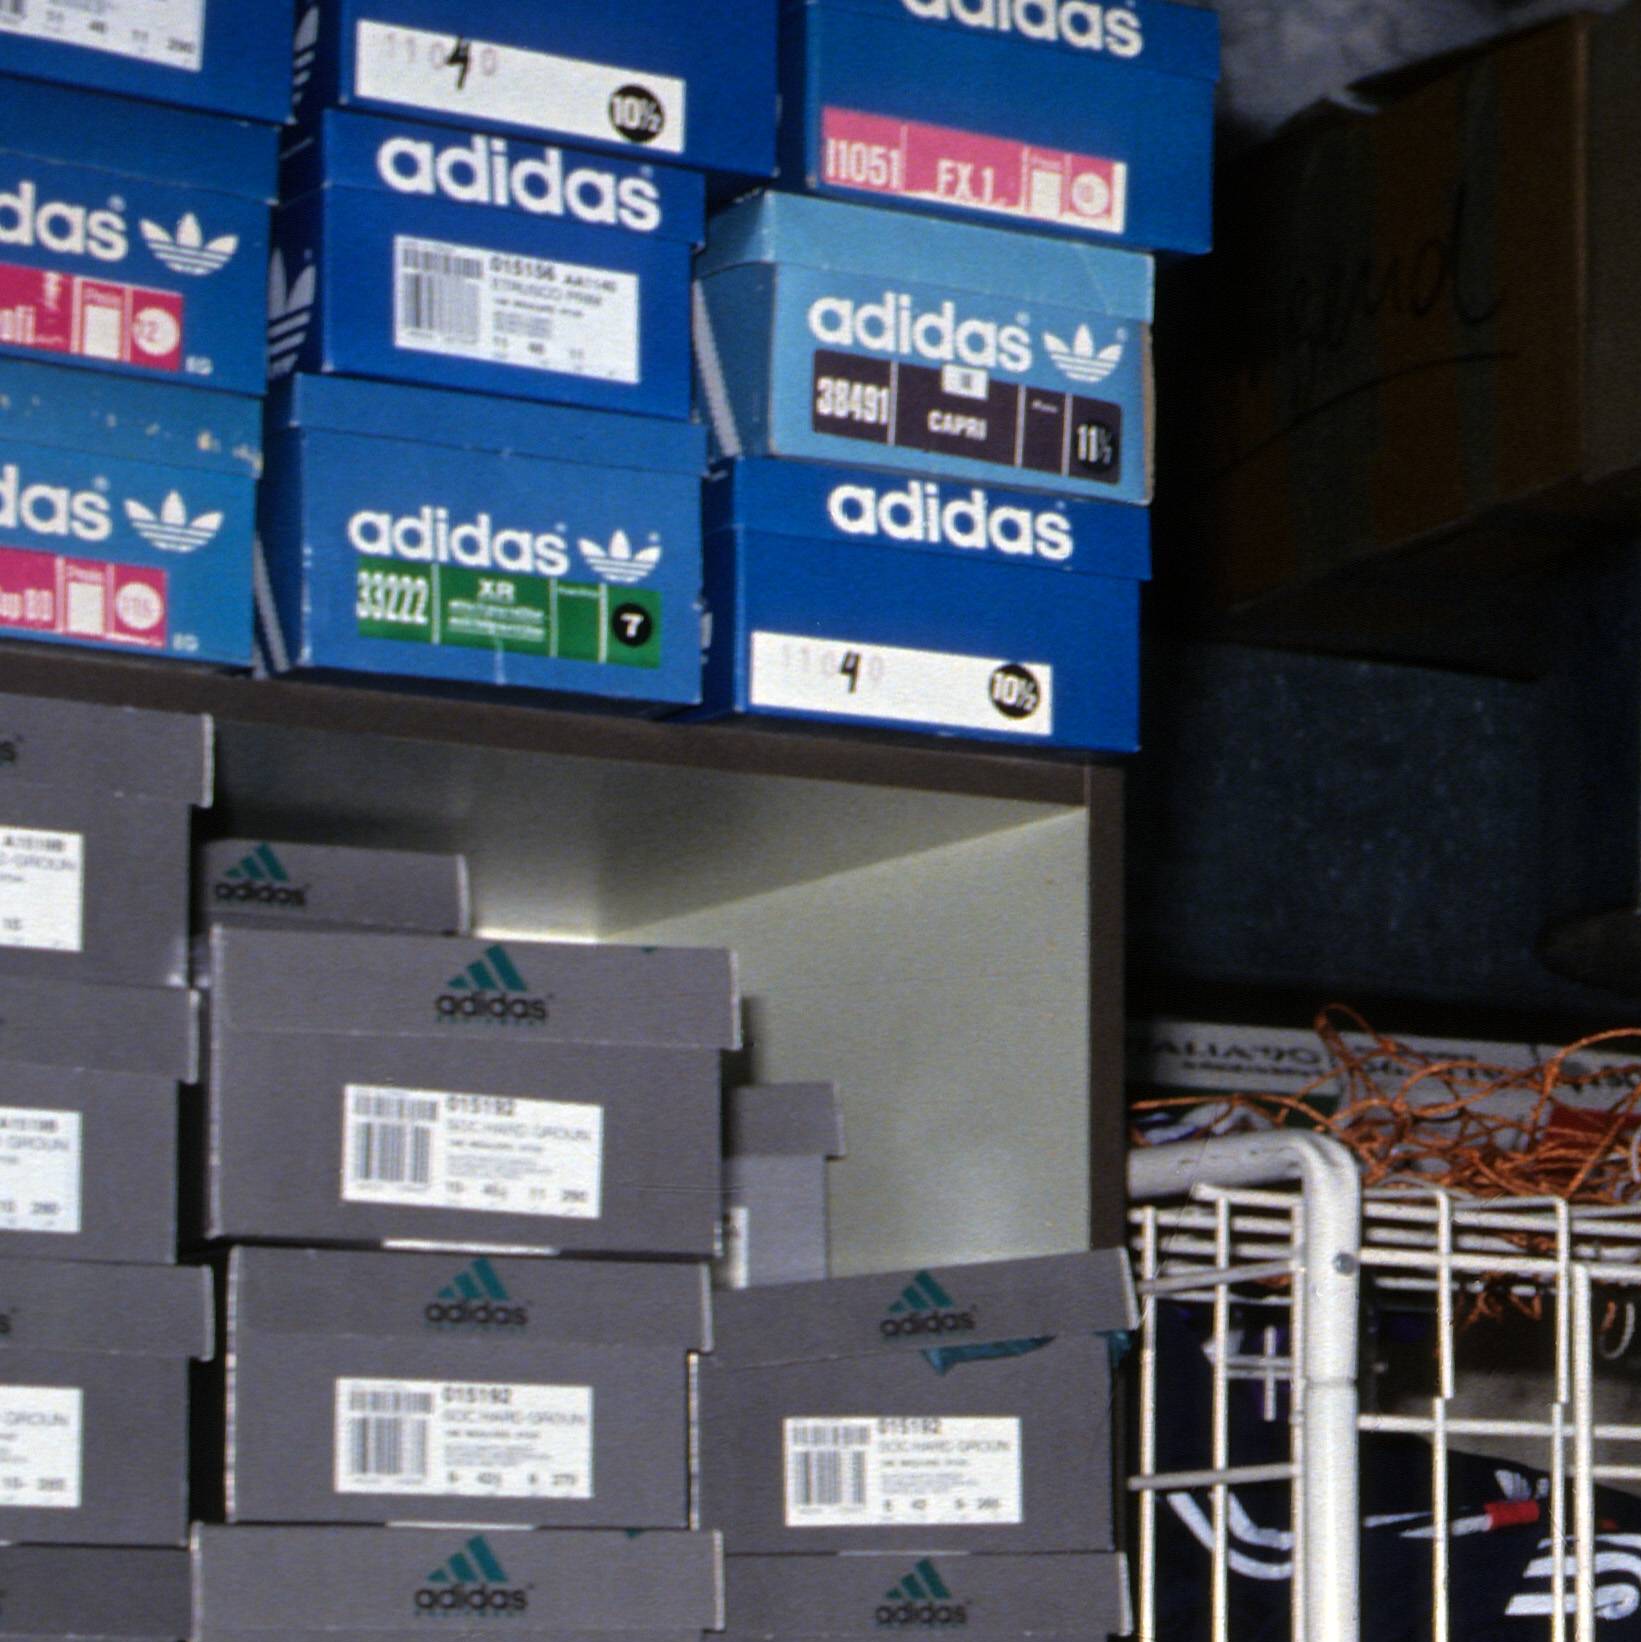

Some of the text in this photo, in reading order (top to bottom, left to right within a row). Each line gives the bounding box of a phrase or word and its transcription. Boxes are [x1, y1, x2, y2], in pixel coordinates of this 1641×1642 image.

[446, 34, 471, 90] 4
[377, 134, 662, 233] adidas
[825, 137, 902, 189] 11051
[808, 292, 1032, 373] adidas
[815, 375, 890, 426] 38491
[927, 409, 987, 442] CAPRI
[348, 506, 571, 577] adidas
[827, 480, 1074, 561] adidas
[355, 572, 429, 627] 33222
[619, 610, 647, 638] 7
[839, 650, 861, 694] 4
[214, 882, 306, 907] adidas
[435, 990, 547, 1021] adidas
[424, 1300, 529, 1328] adidas
[880, 1308, 976, 1339] adidas
[413, 1584, 528, 1614] adidas
[876, 1602, 968, 1626] adidas
